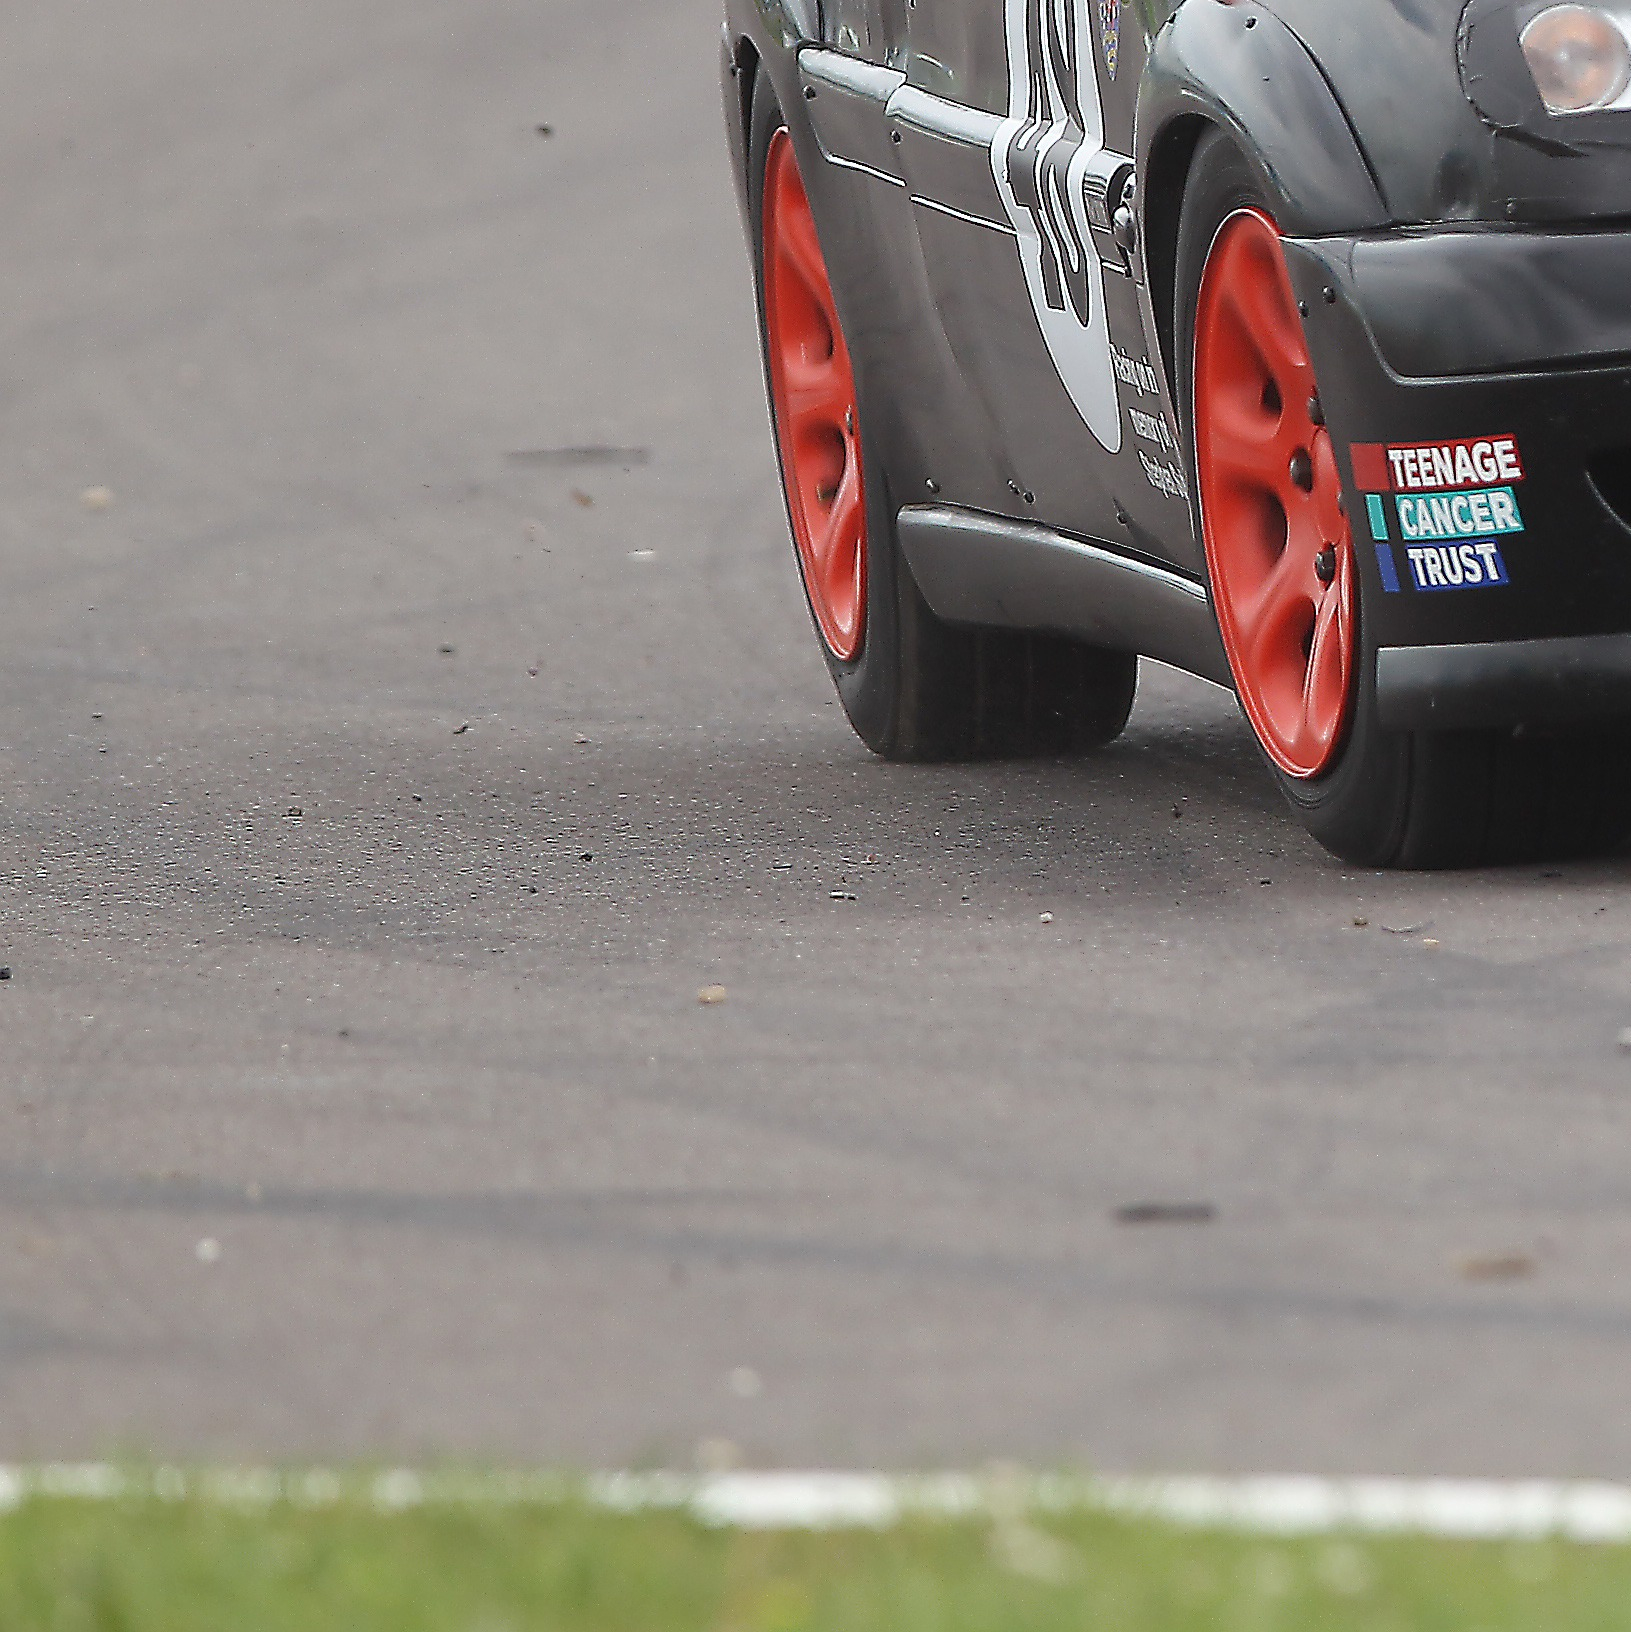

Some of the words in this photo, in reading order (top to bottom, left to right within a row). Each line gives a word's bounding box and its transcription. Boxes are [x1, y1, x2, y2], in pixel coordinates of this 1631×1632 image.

[1389, 440, 1520, 488] TEENAGE
[1399, 491, 1519, 536] CANCER
[1407, 543, 1500, 587] TRUST
